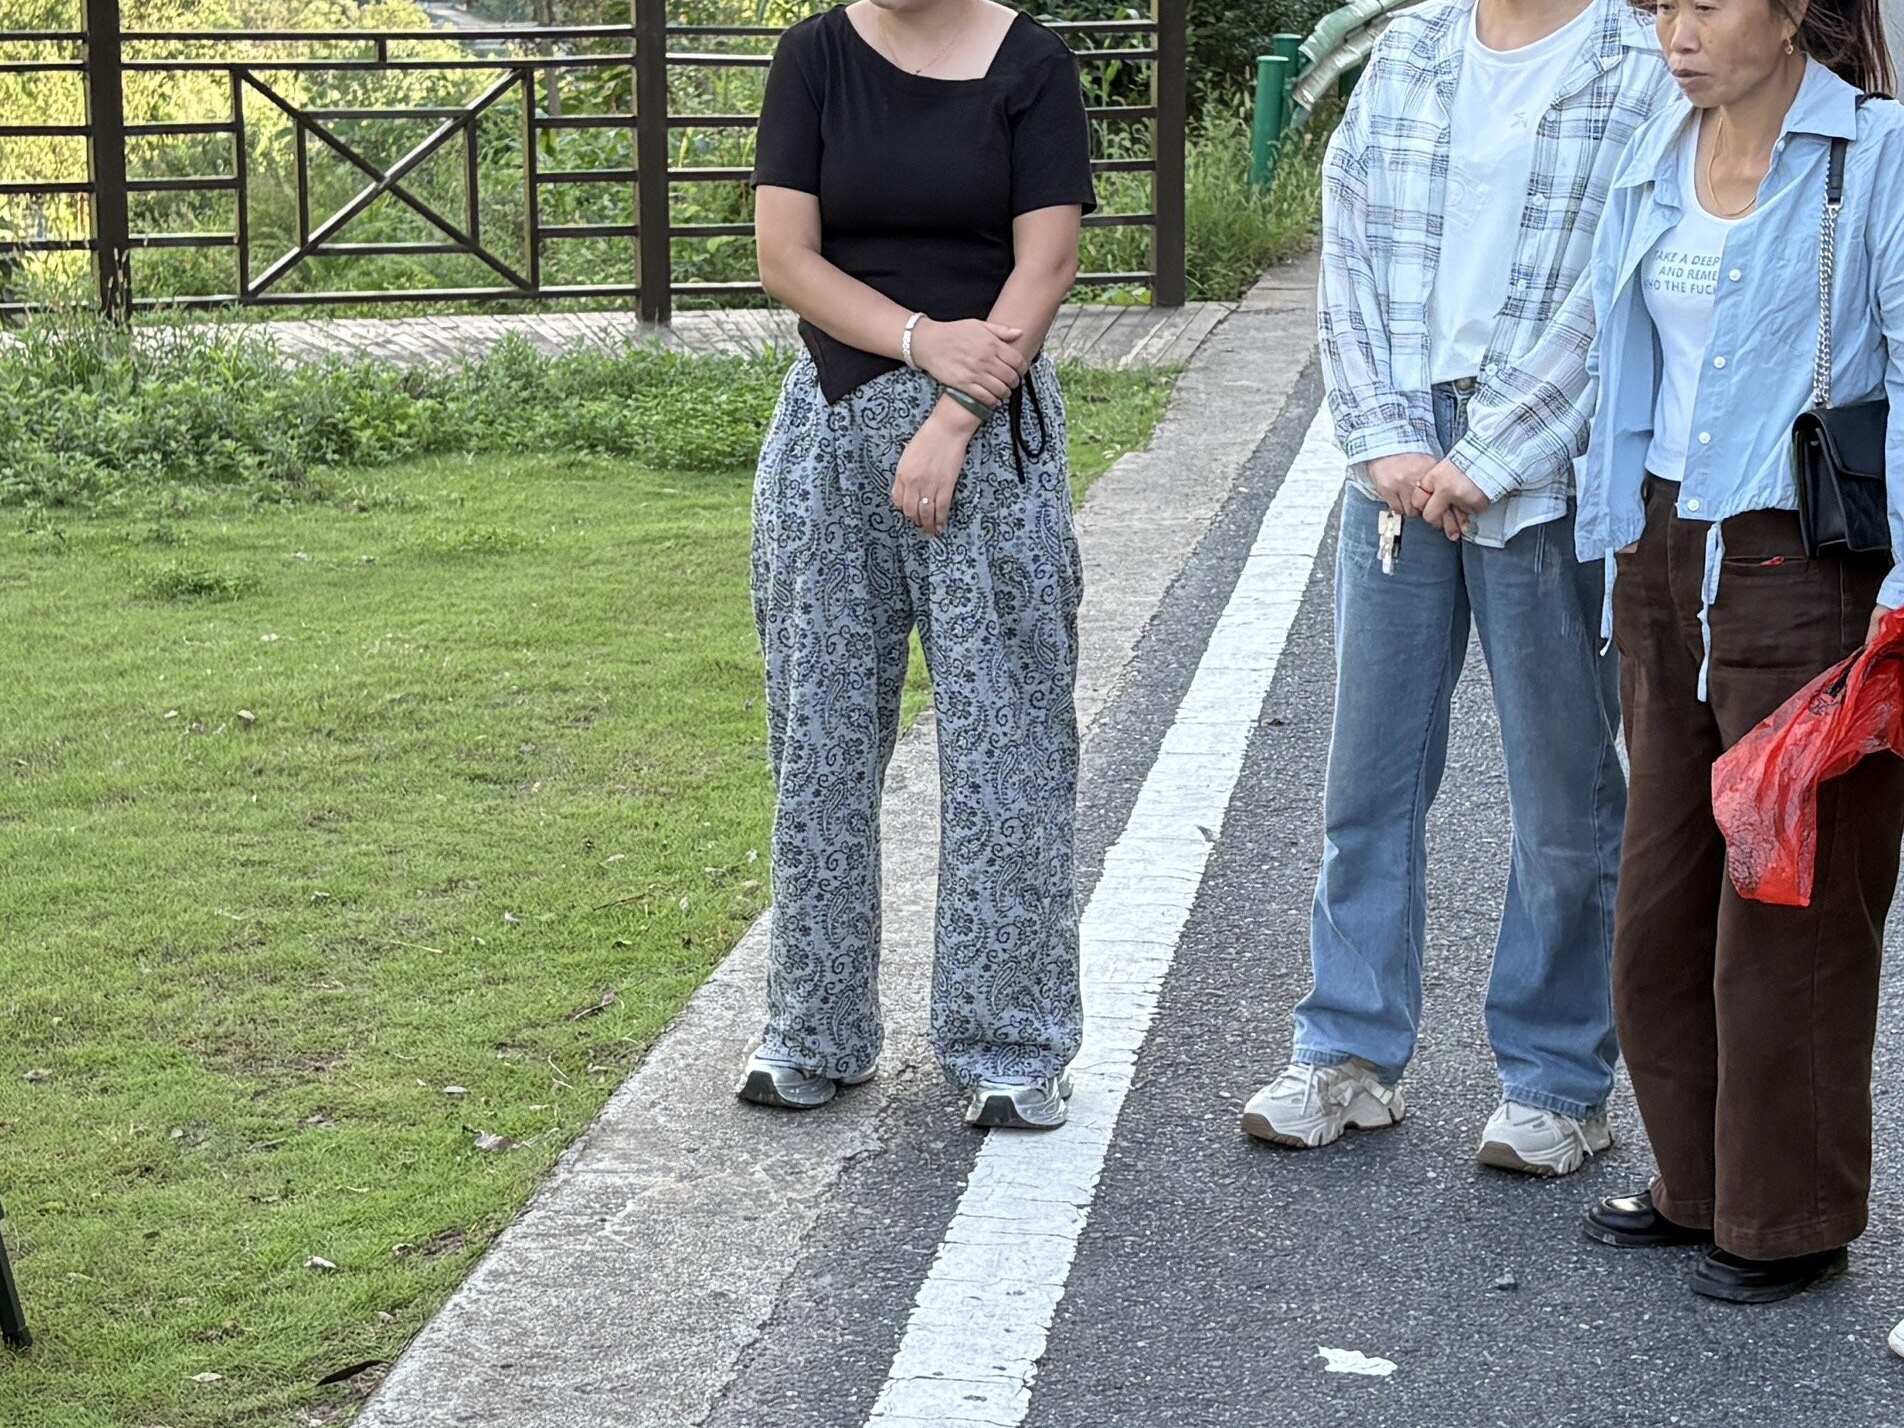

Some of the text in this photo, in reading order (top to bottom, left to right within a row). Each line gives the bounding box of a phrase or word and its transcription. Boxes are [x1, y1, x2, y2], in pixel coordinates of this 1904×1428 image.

[1678, 253, 1689, 265] A
[1691, 255, 1721, 267] DEEP
[1658, 266, 1685, 278] AND
[1664, 280, 1687, 293] THE
